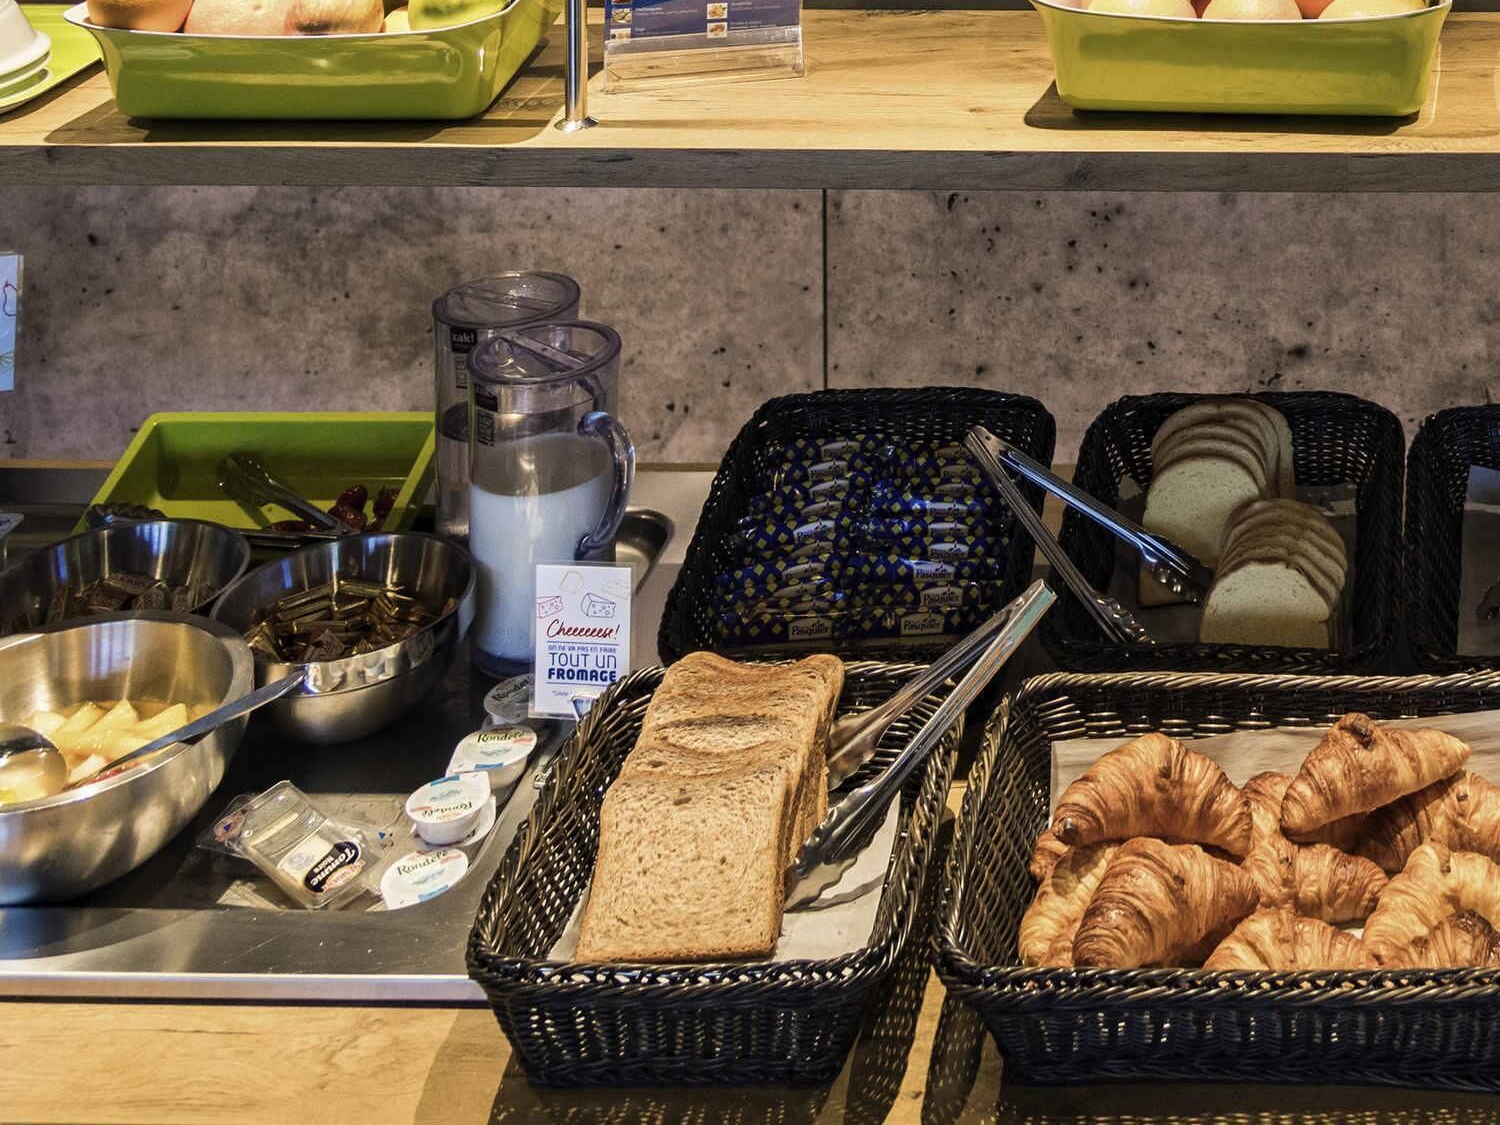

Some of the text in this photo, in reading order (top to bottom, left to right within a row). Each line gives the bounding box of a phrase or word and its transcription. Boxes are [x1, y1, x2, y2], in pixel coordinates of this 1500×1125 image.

[452, 331, 474, 344] zak!
[549, 651, 589, 668] TOUT
[547, 667, 617, 683] FROMAGE
